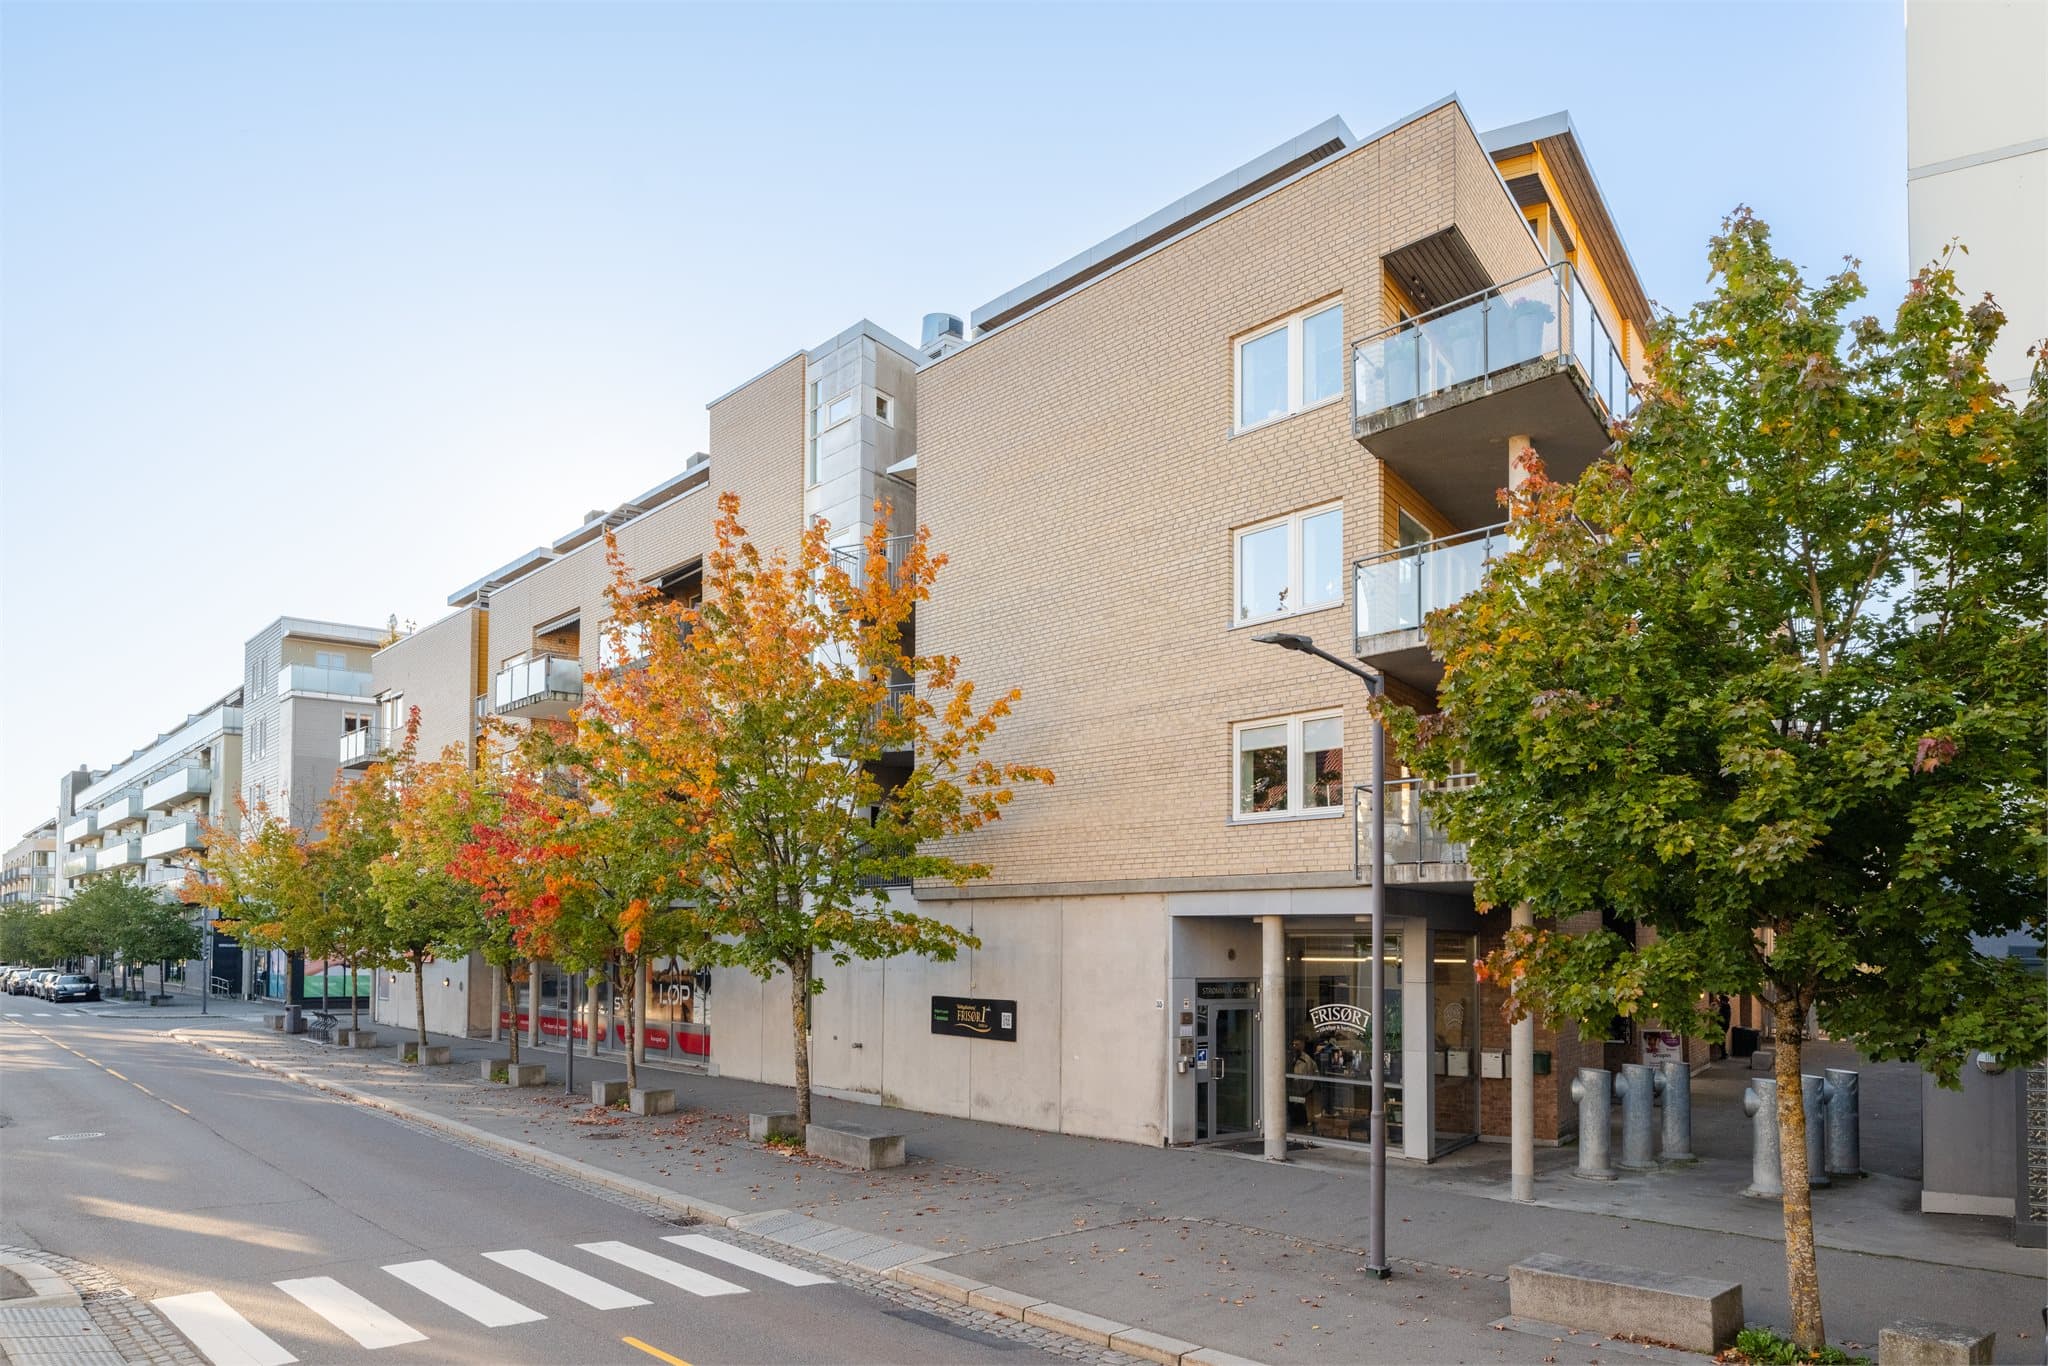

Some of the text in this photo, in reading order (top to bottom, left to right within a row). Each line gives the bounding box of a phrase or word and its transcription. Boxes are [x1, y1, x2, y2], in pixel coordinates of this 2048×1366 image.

[659, 983, 691, 1006] LØP
[957, 1010, 981, 1023] FRISØR
[981, 1006, 987, 1023] 1
[1310, 1007, 1370, 1028] FRISØR 1
